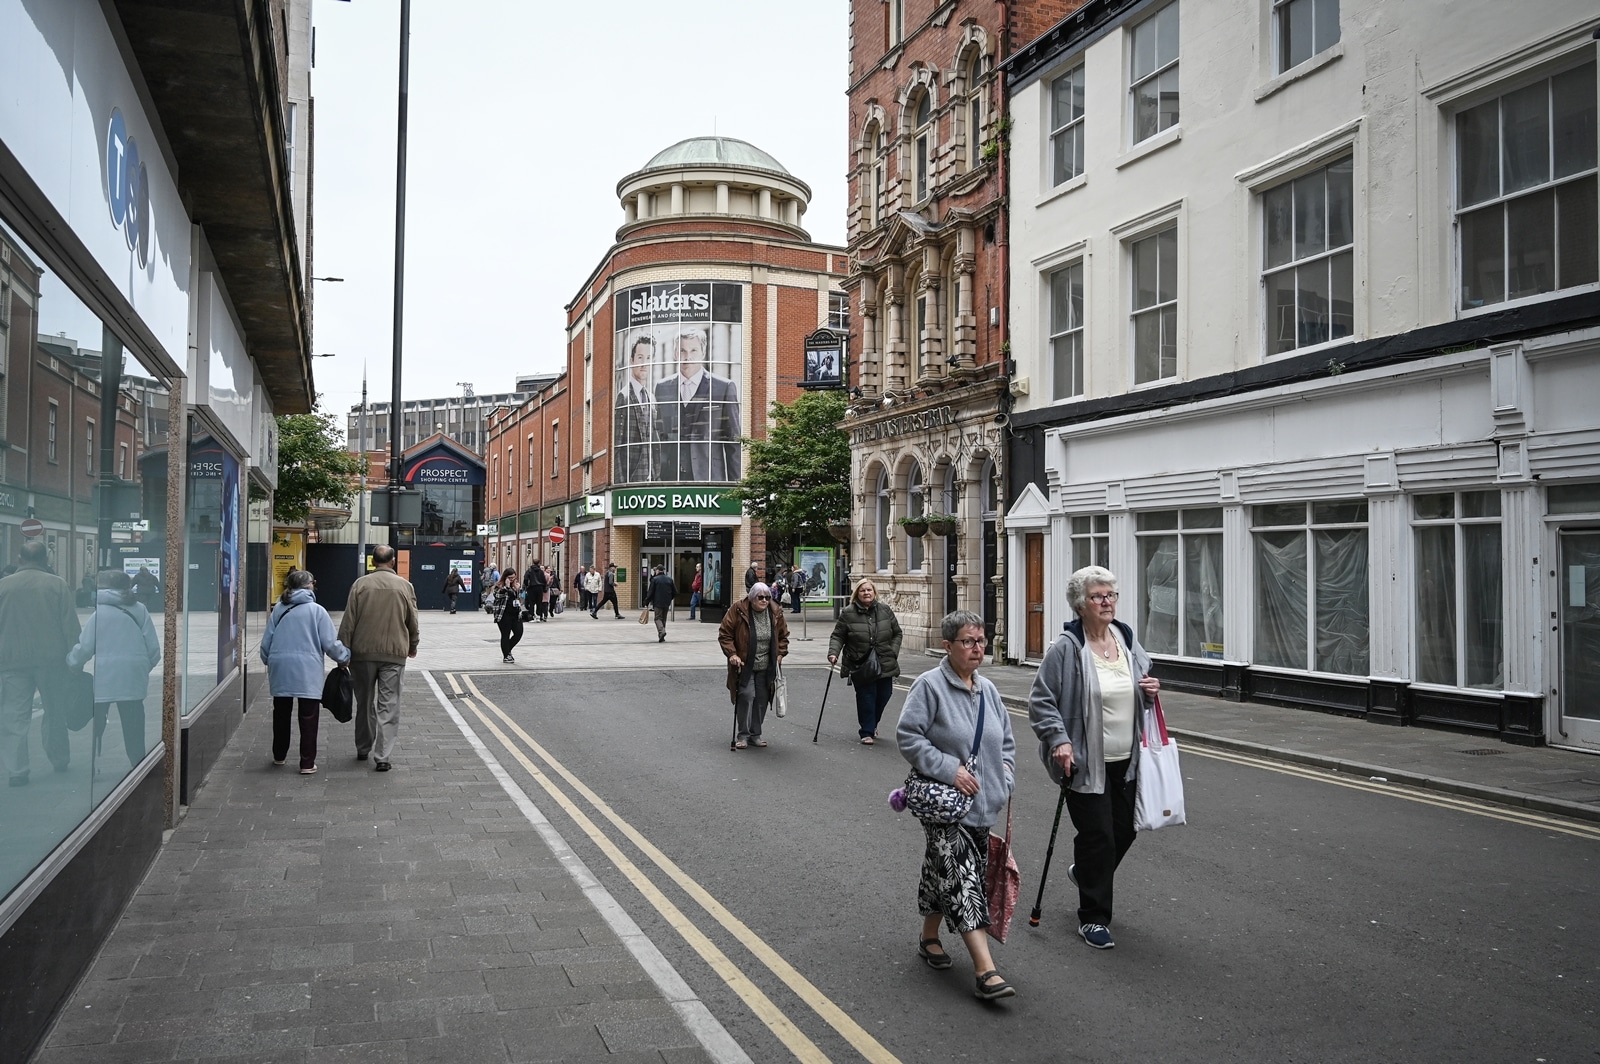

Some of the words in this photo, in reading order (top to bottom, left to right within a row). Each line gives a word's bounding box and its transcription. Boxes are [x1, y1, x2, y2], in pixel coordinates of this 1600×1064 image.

[631, 289, 709, 315] slaters
[853, 424, 871, 444] THE
[875, 411, 923, 439] MASTERS
[926, 406, 953, 427] BAR
[420, 468, 468, 478] PROSPECT
[618, 494, 667, 509] LLOYDS
[672, 494, 720, 508] BANK
